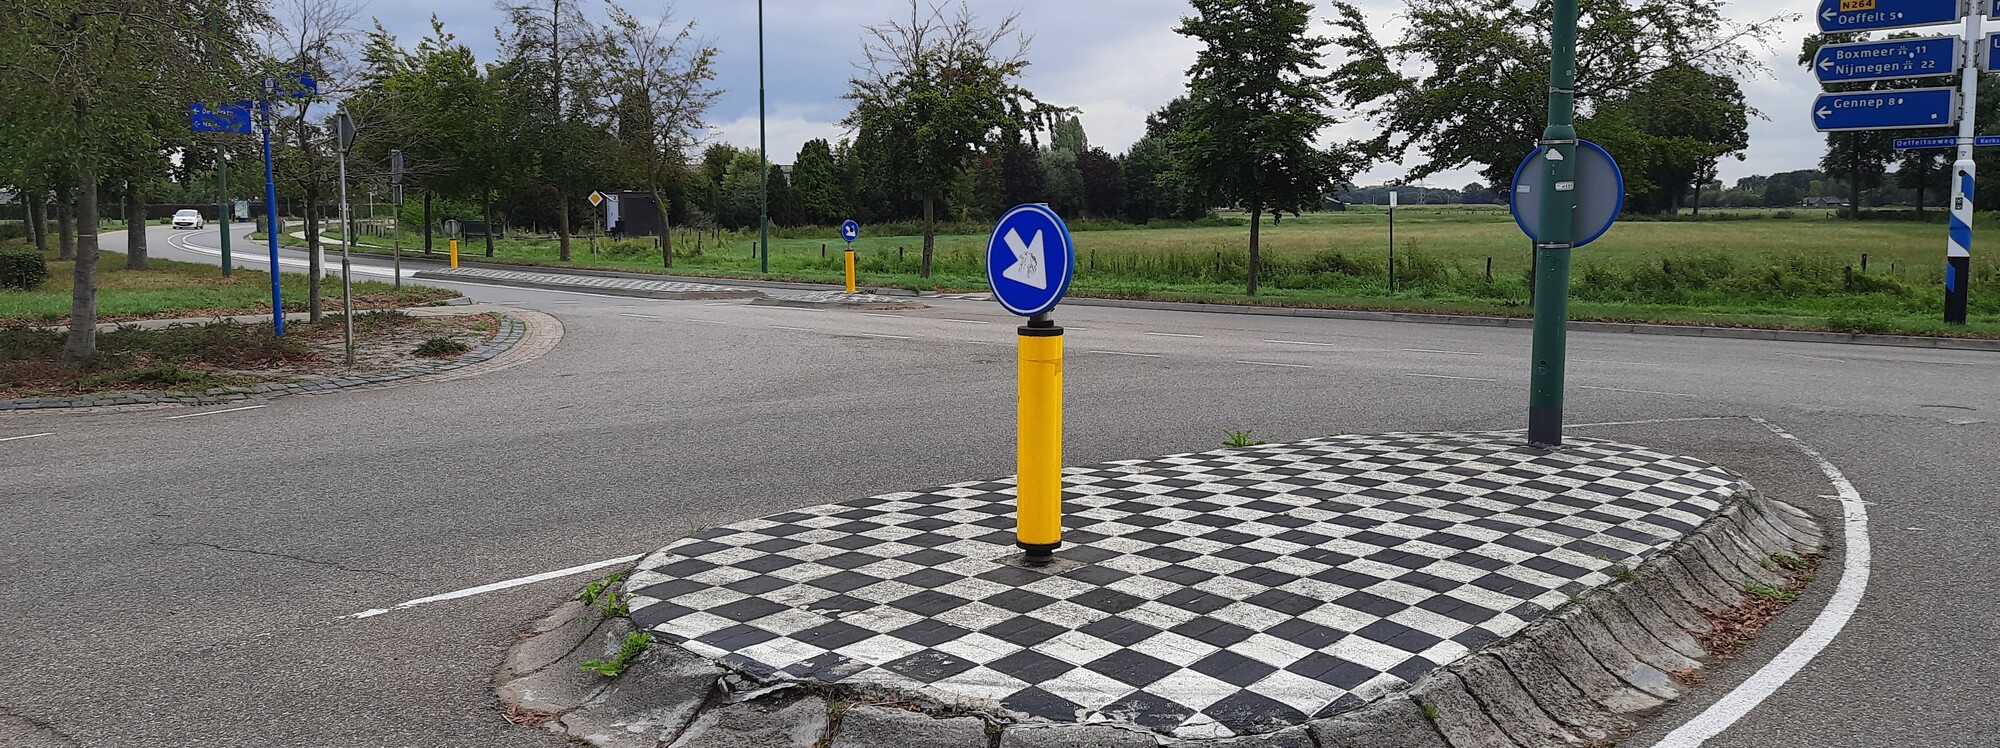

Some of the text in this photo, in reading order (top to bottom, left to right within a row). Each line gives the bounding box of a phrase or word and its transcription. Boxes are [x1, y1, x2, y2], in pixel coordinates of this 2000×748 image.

[1838, 11, 1896, 24] Oeffelt 5
[1836, 45, 1927, 60] Boxmeer 11
[1835, 60, 1935, 76] Nijmegen 22
[1833, 97, 1895, 108] Gennep 8
[1896, 138, 1954, 147] Oeffeltseweg
